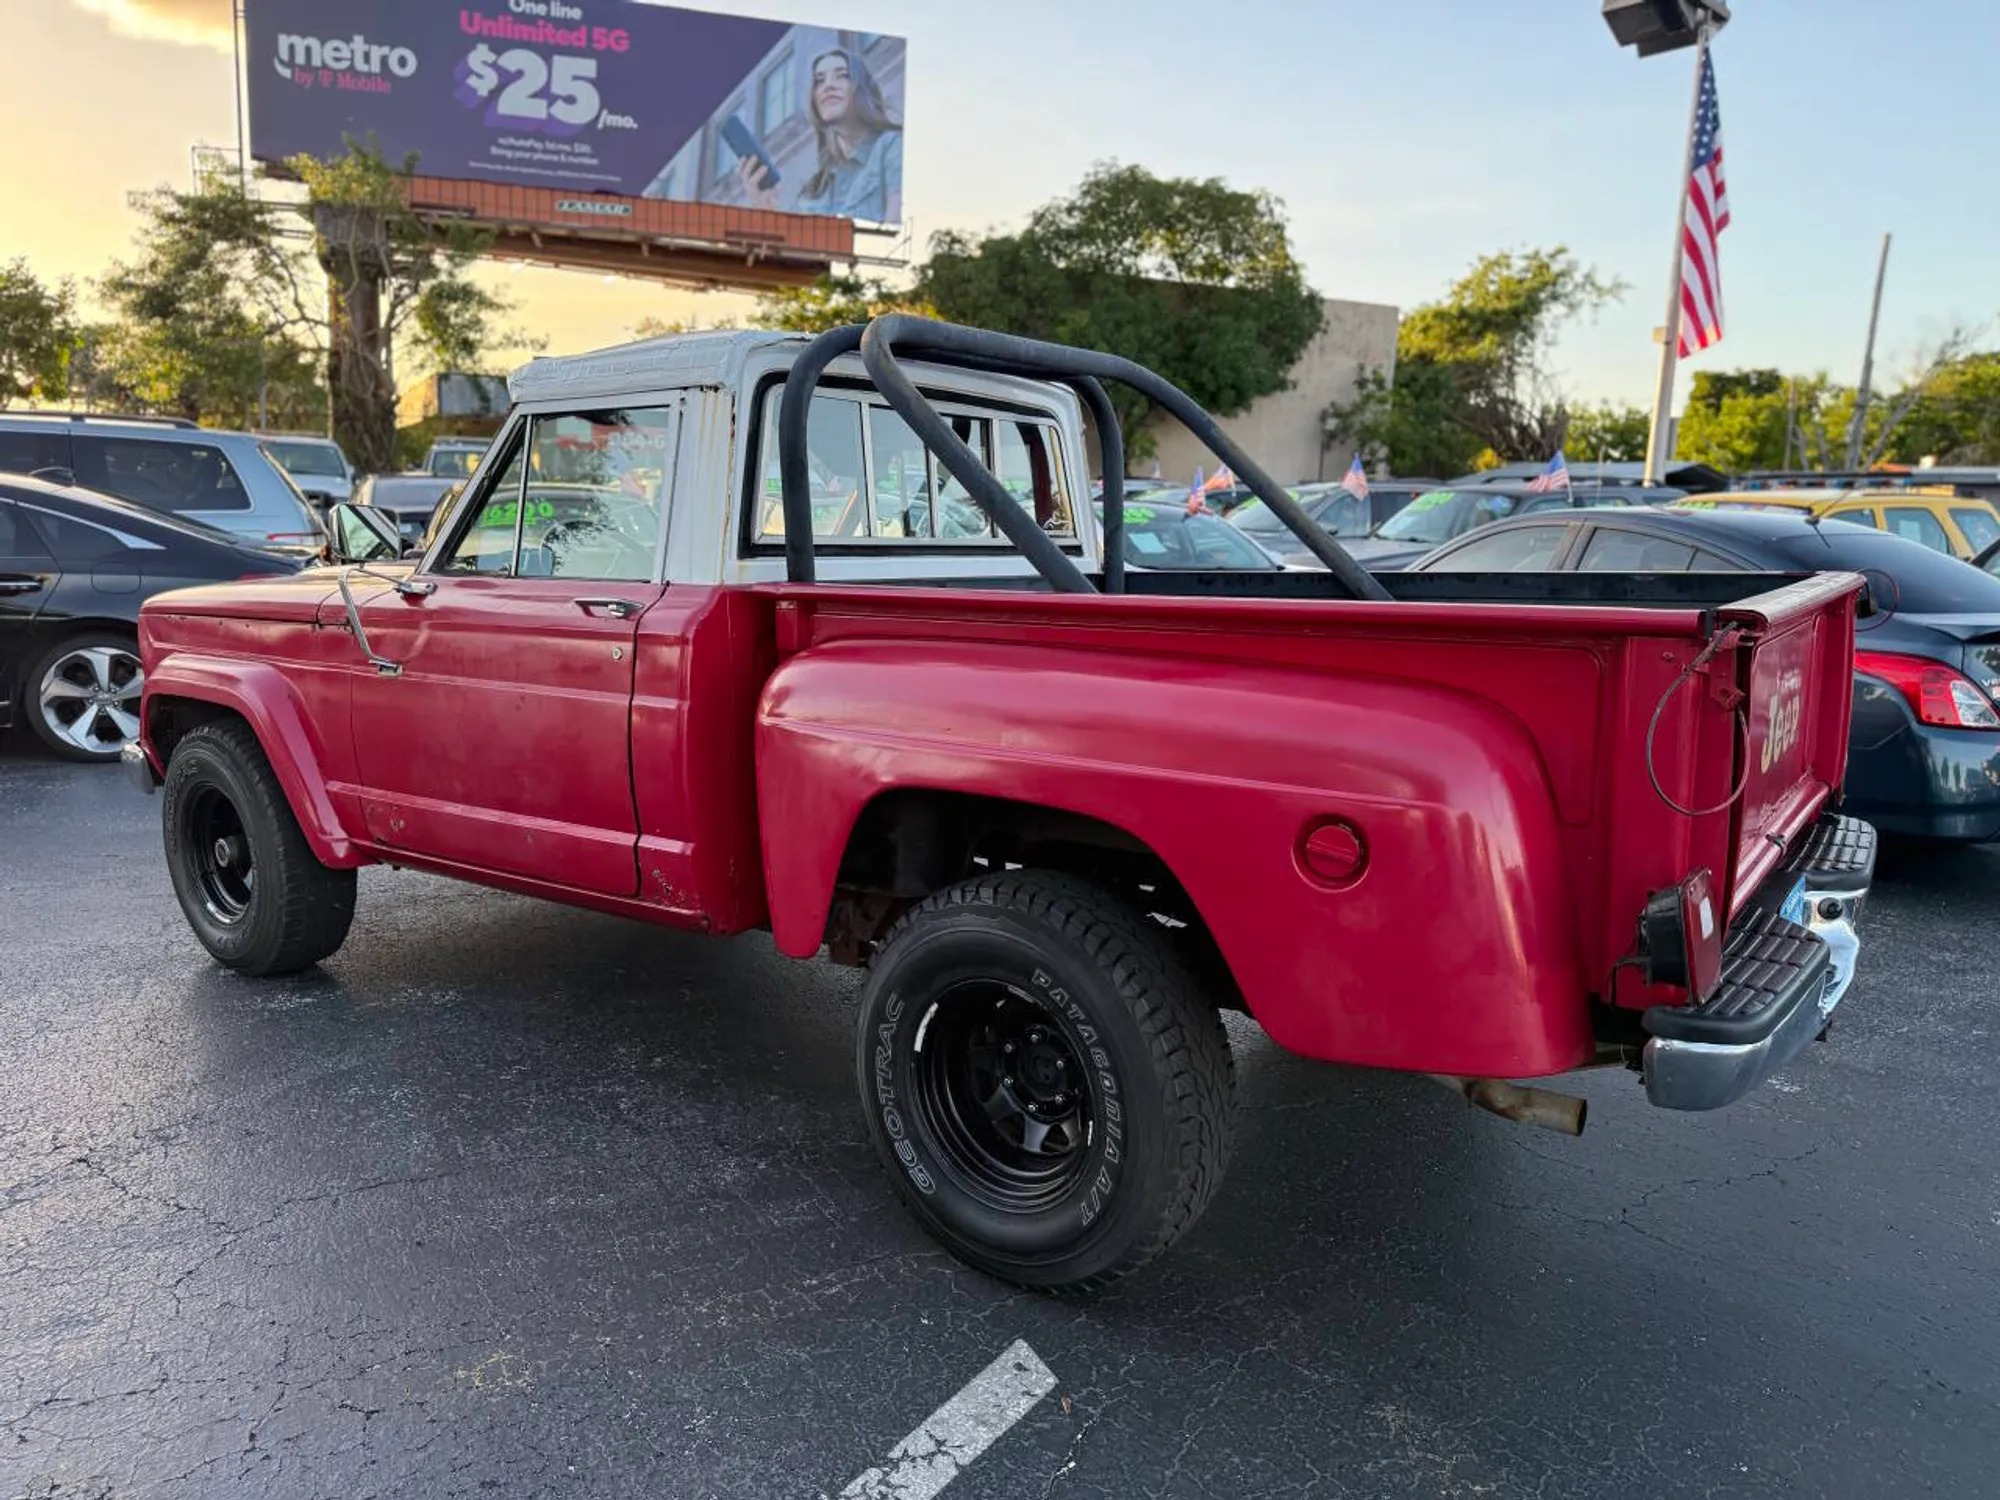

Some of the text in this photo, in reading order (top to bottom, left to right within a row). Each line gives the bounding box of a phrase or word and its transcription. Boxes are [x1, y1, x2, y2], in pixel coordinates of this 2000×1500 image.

[460, 9, 630, 52] Unlimited 5G
[508, 0, 583, 21] One line
[277, 33, 418, 77] metro
[294, 66, 315, 89] by
[466, 43, 600, 125] $25
[1761, 694, 1800, 774] Jeep
[876, 992, 936, 1195] GEOTRAC
[1031, 968, 1122, 1226] PATAGONIA A/T
